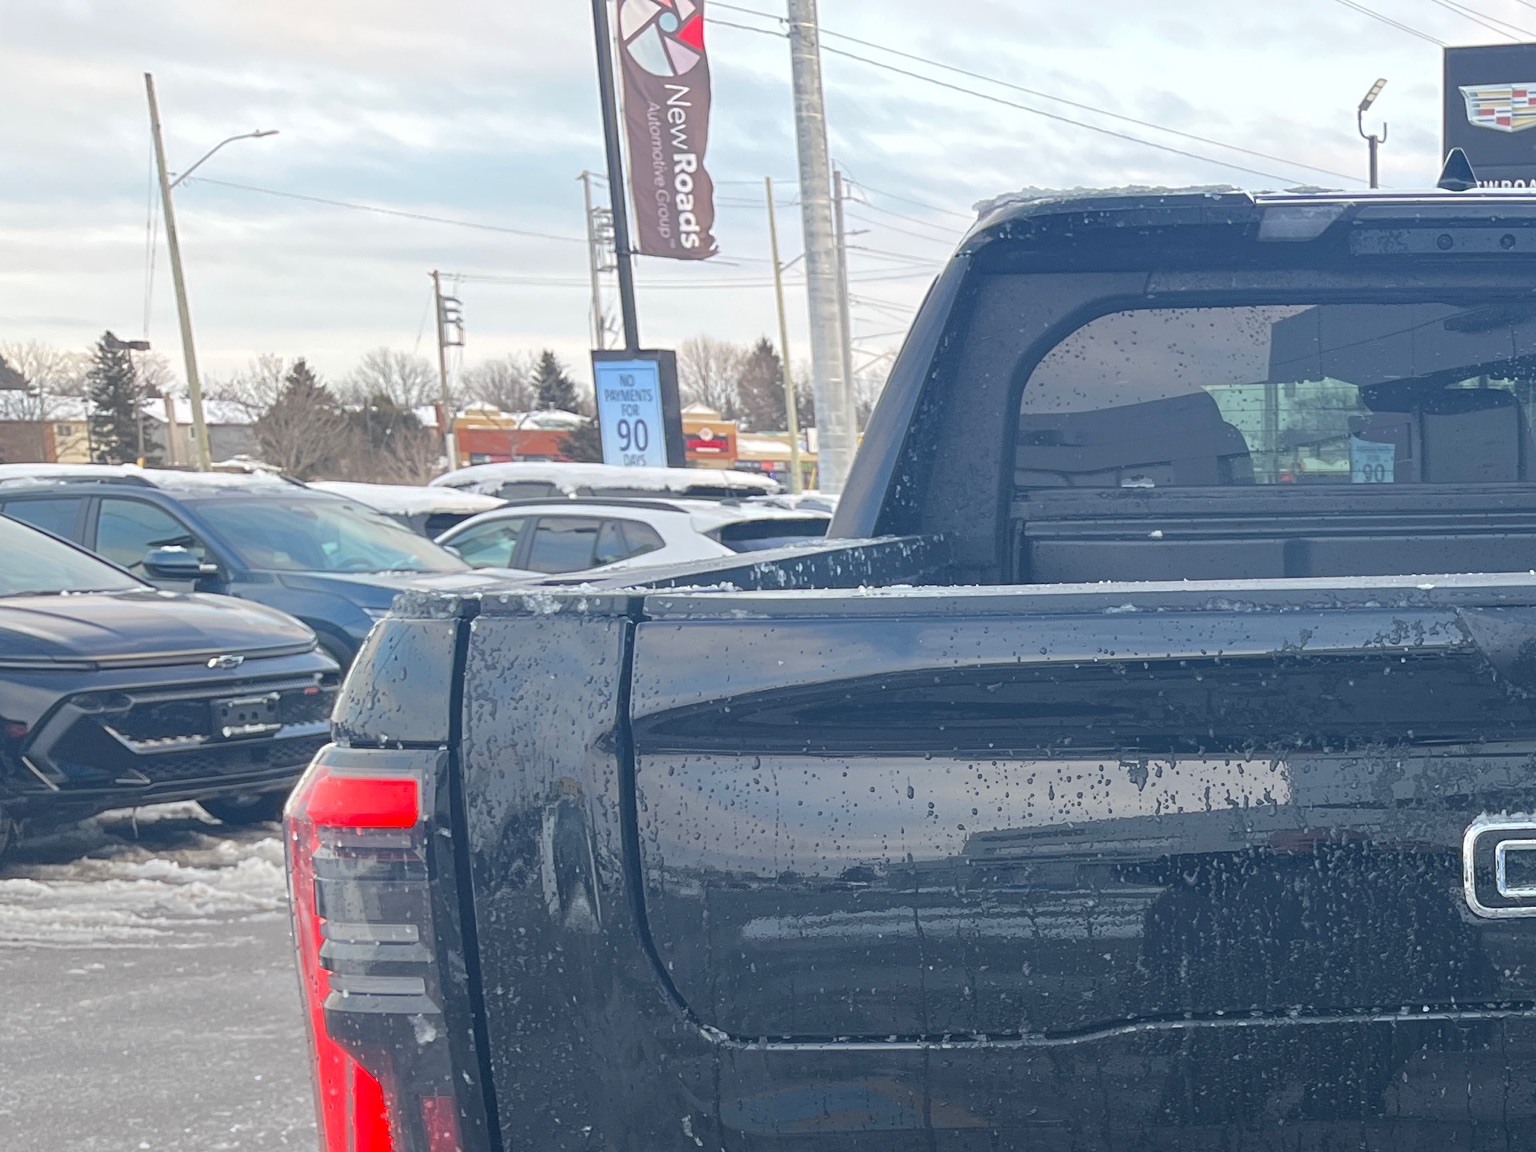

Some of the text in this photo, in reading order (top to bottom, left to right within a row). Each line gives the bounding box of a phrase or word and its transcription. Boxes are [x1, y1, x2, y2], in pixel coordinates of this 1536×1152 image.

[646, 101, 672, 239] Automotive Group
[619, 374, 635, 387] NO
[604, 388, 653, 402] PAYMENTS
[621, 403, 640, 417] FOR
[616, 418, 649, 452] 90
[623, 453, 647, 467] DAYS
[1363, 464, 1386, 482] 90
